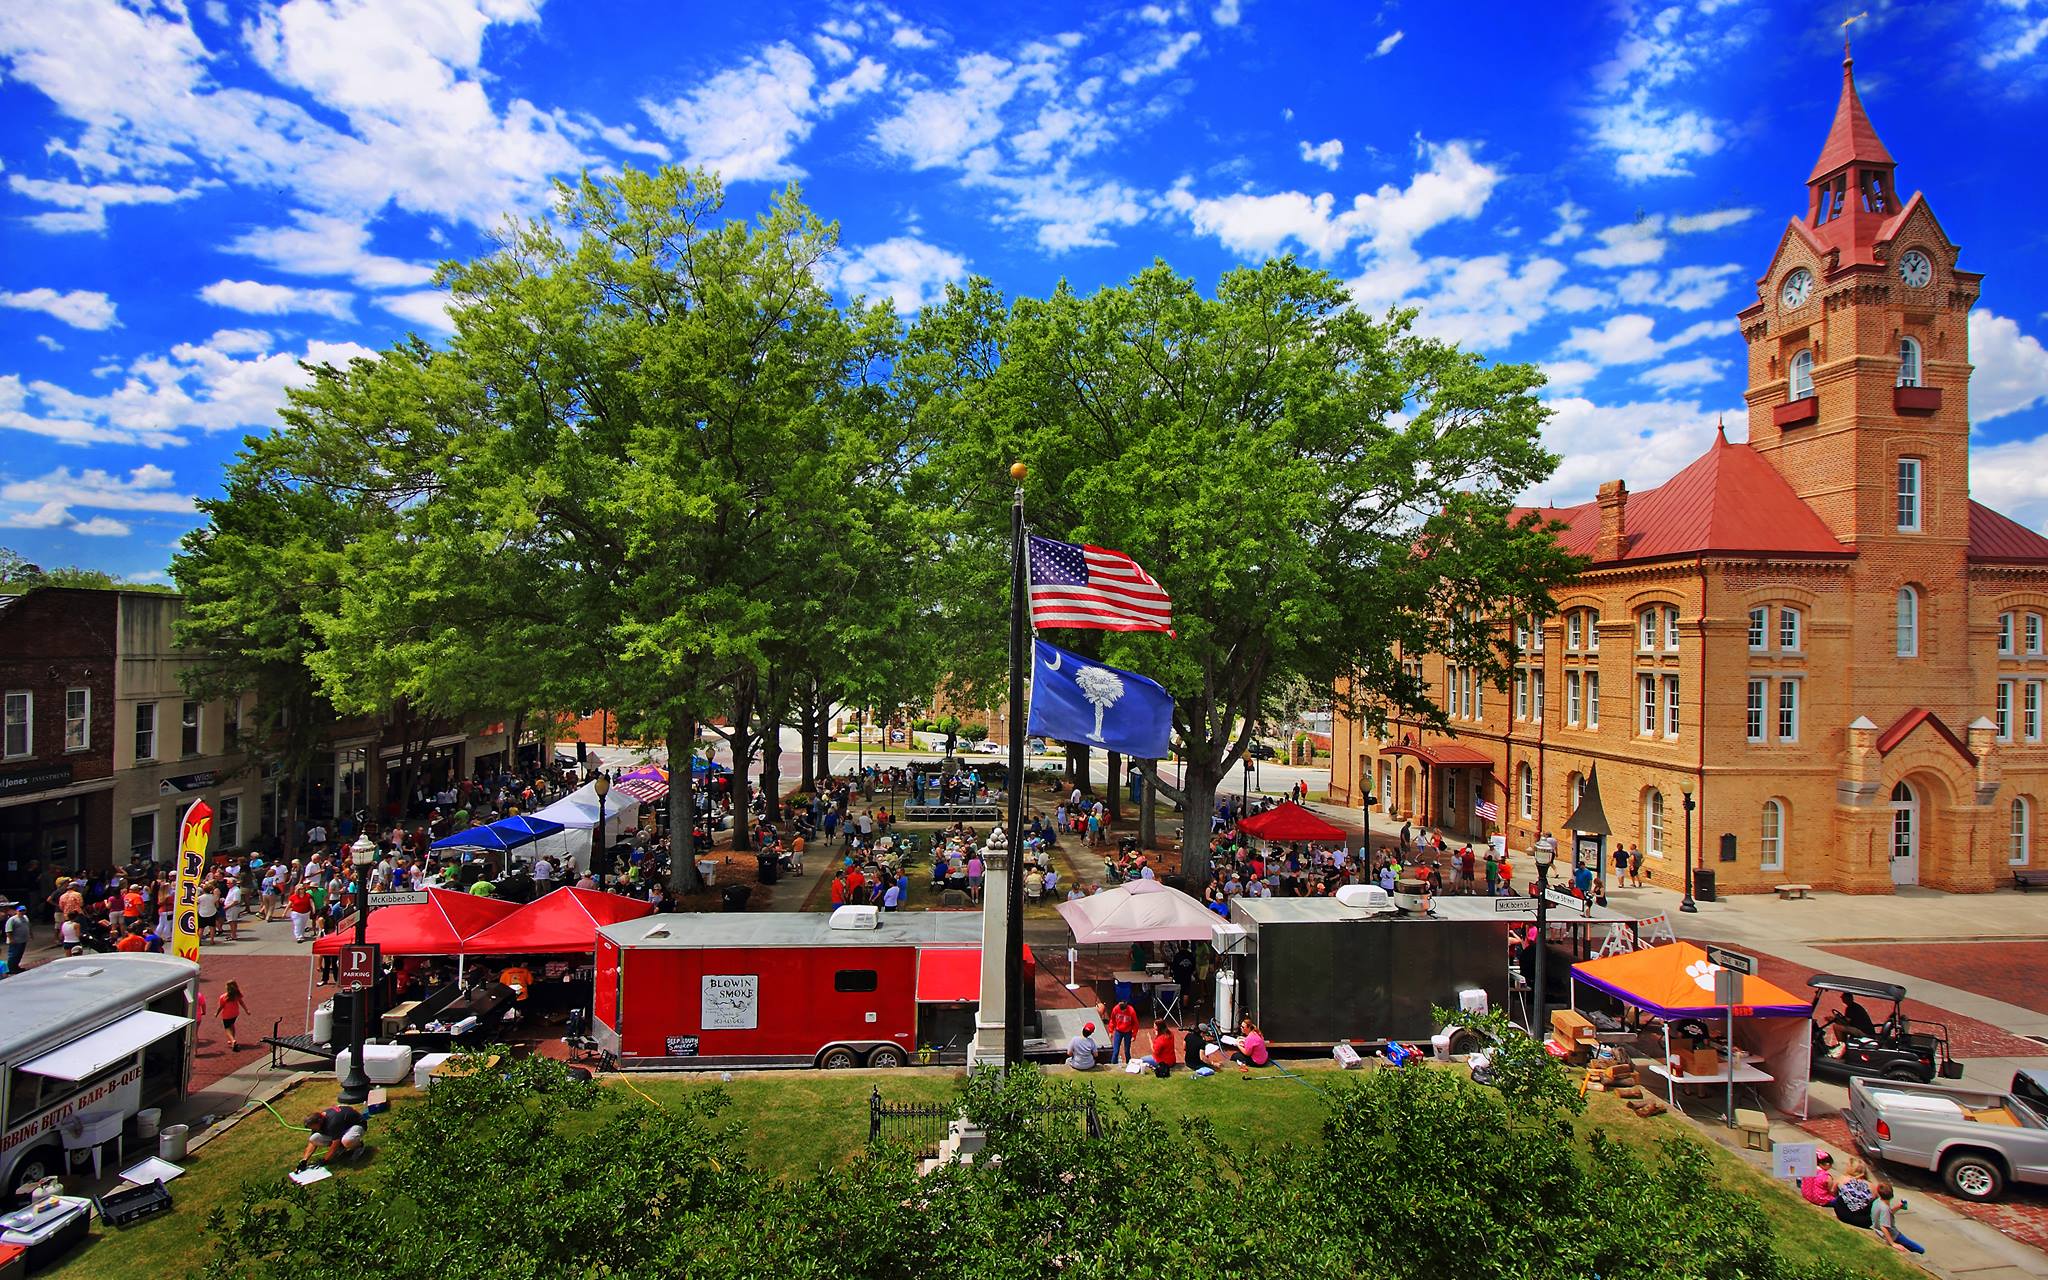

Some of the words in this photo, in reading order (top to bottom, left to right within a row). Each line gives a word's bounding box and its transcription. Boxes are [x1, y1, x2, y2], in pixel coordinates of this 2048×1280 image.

[5, 777, 28, 788] Jones
[370, 895, 405, 904] McKibben
[406, 894, 417, 903] St.
[351, 951, 367, 970] P
[1720, 956, 1733, 965] ONE
[1734, 960, 1746, 968] WAY
[710, 978, 754, 988] BLOWIN'
[719, 989, 754, 998] SMOKE
[41, 1102, 74, 1132] BUTTS
[78, 1065, 142, 1110] BAR-B-QUE
